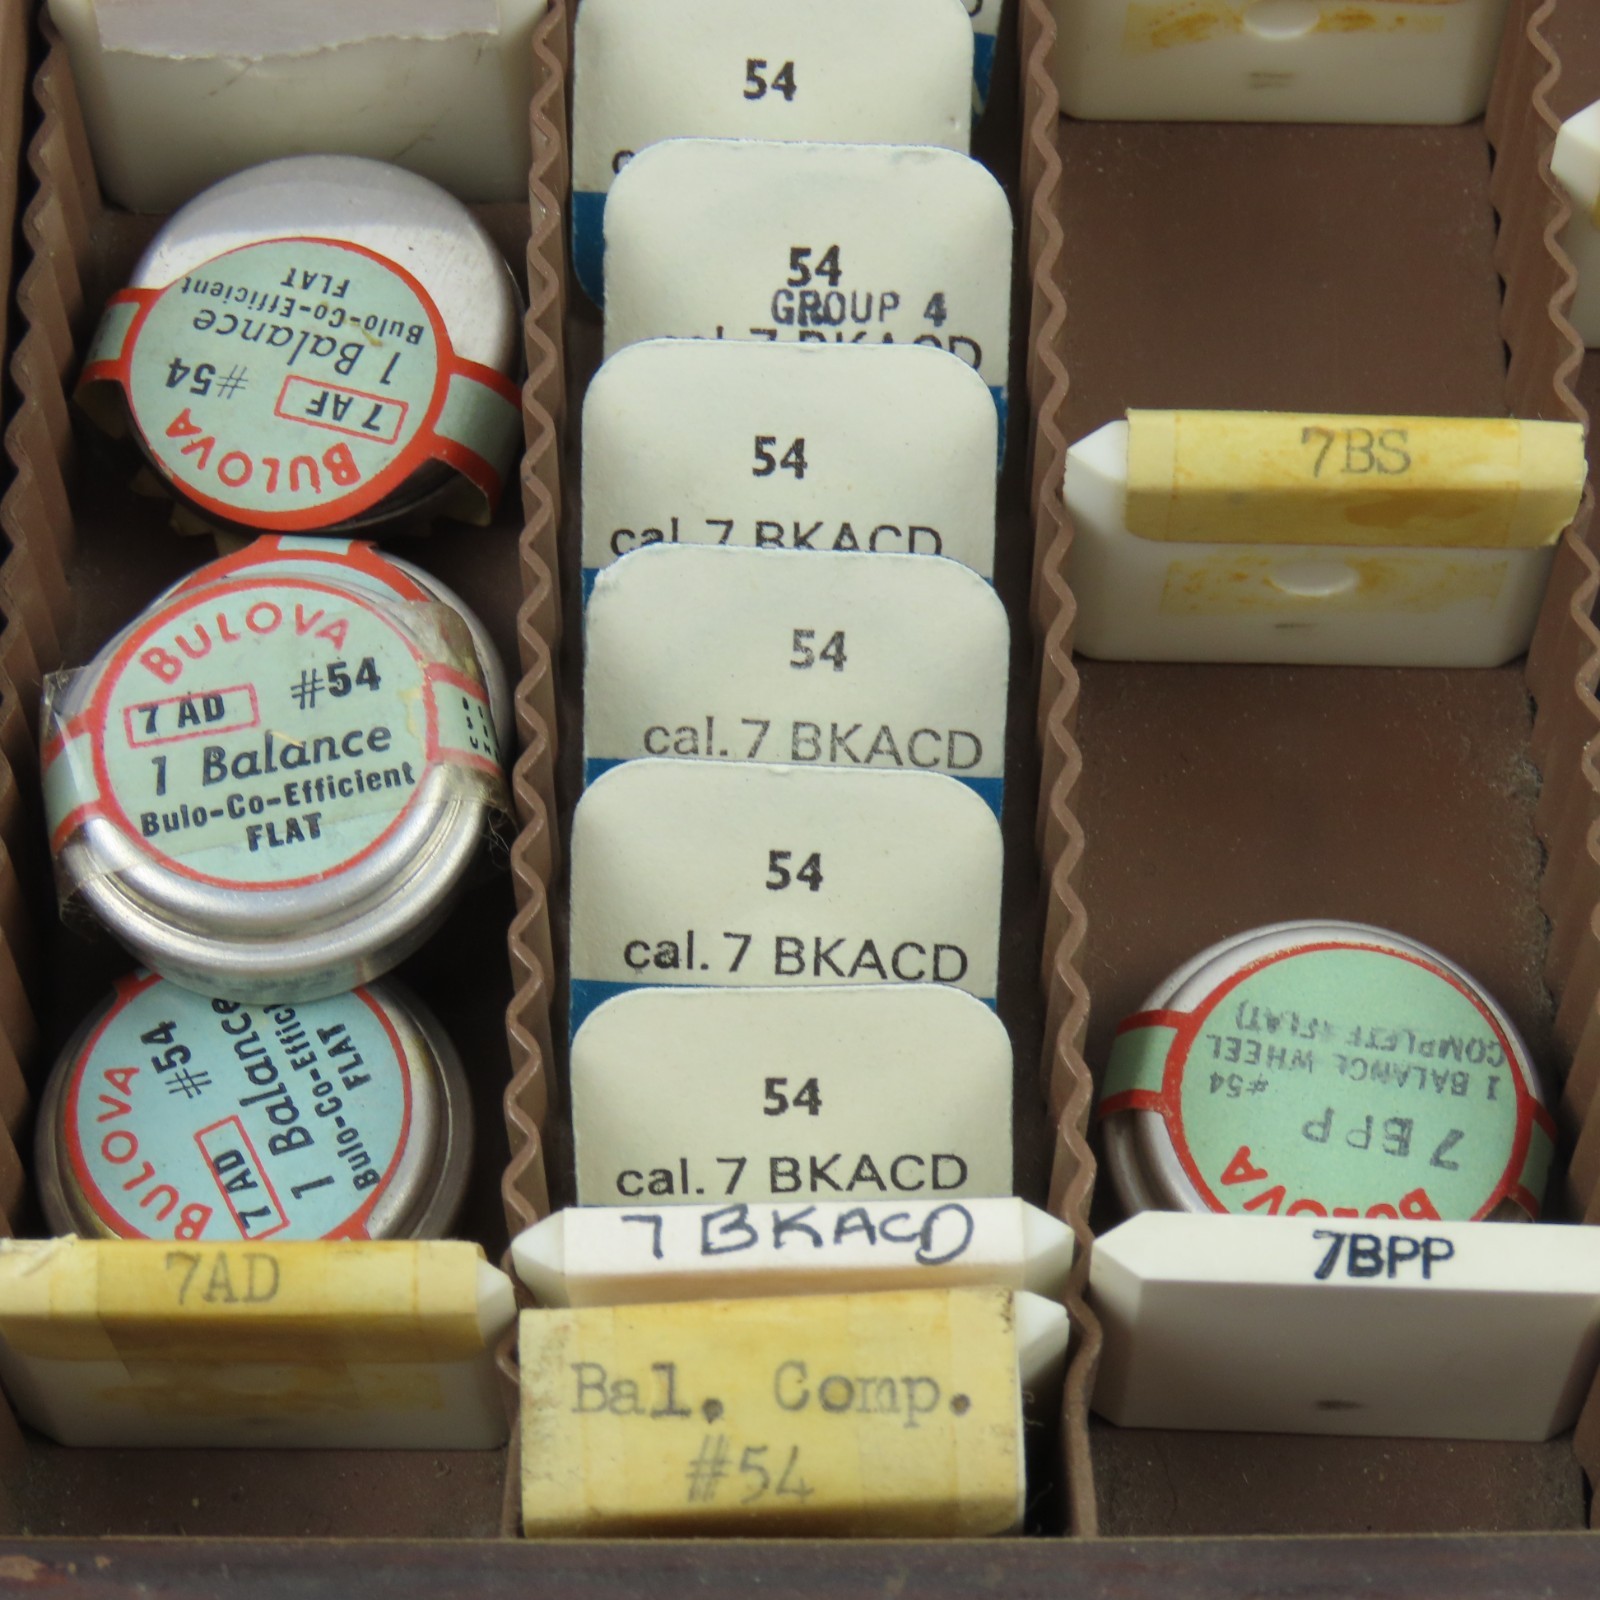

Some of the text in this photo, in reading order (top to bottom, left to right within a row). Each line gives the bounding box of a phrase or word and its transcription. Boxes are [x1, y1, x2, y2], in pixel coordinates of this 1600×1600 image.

[743, 58, 797, 101] 54
[280, 267, 350, 298] FLAT
[787, 244, 842, 287] 54
[181, 276, 424, 344] Bulo-Co-Efficient
[771, 288, 947, 327] GROUP 4
[194, 308, 402, 385] 1 Balance
[166, 357, 248, 399] #54
[306, 391, 382, 431] 7 AF
[166, 408, 361, 494] BULOVA
[751, 436, 808, 479] 54
[1301, 426, 1411, 478] 7BS
[754, 520, 943, 557] BKACD
[140, 601, 348, 684] BULOVA
[790, 629, 847, 672] 54
[290, 657, 381, 709] #54
[138, 693, 225, 734] 7 AD
[152, 726, 392, 796] 1 Balance
[643, 716, 984, 769] cal. 7 BKACD
[141, 762, 416, 838] Bulo-Co-Efficient
[246, 813, 323, 852] FLAT
[765, 850, 823, 892] 54
[623, 930, 968, 982] cal. 7 BKACD
[140, 1020, 212, 1099] #54
[317, 1023, 371, 1091] FLAT
[1207, 1033, 1314, 1073] WHEEL
[1344, 1024, 1506, 1067] COMPLETE
[212, 998, 315, 1156] Balance
[763, 1077, 822, 1116] 54
[1209, 1071, 1269, 1098] #54
[1332, 1053, 1469, 1096] BALANCE
[97, 1066, 213, 1241] BULOVA
[1430, 1129, 1465, 1171] 7
[212, 1149, 272, 1229] 7 AD
[291, 1175, 335, 1200] 1
[616, 1154, 969, 1197] cal. 7 BKACD
[622, 1203, 975, 1266] 7 BKACD
[1313, 1230, 1455, 1279] 7BPP
[166, 1250, 281, 1306] 7AD
[570, 1360, 970, 1428] Bal. Comp.
[687, 1434, 813, 1504] #54
